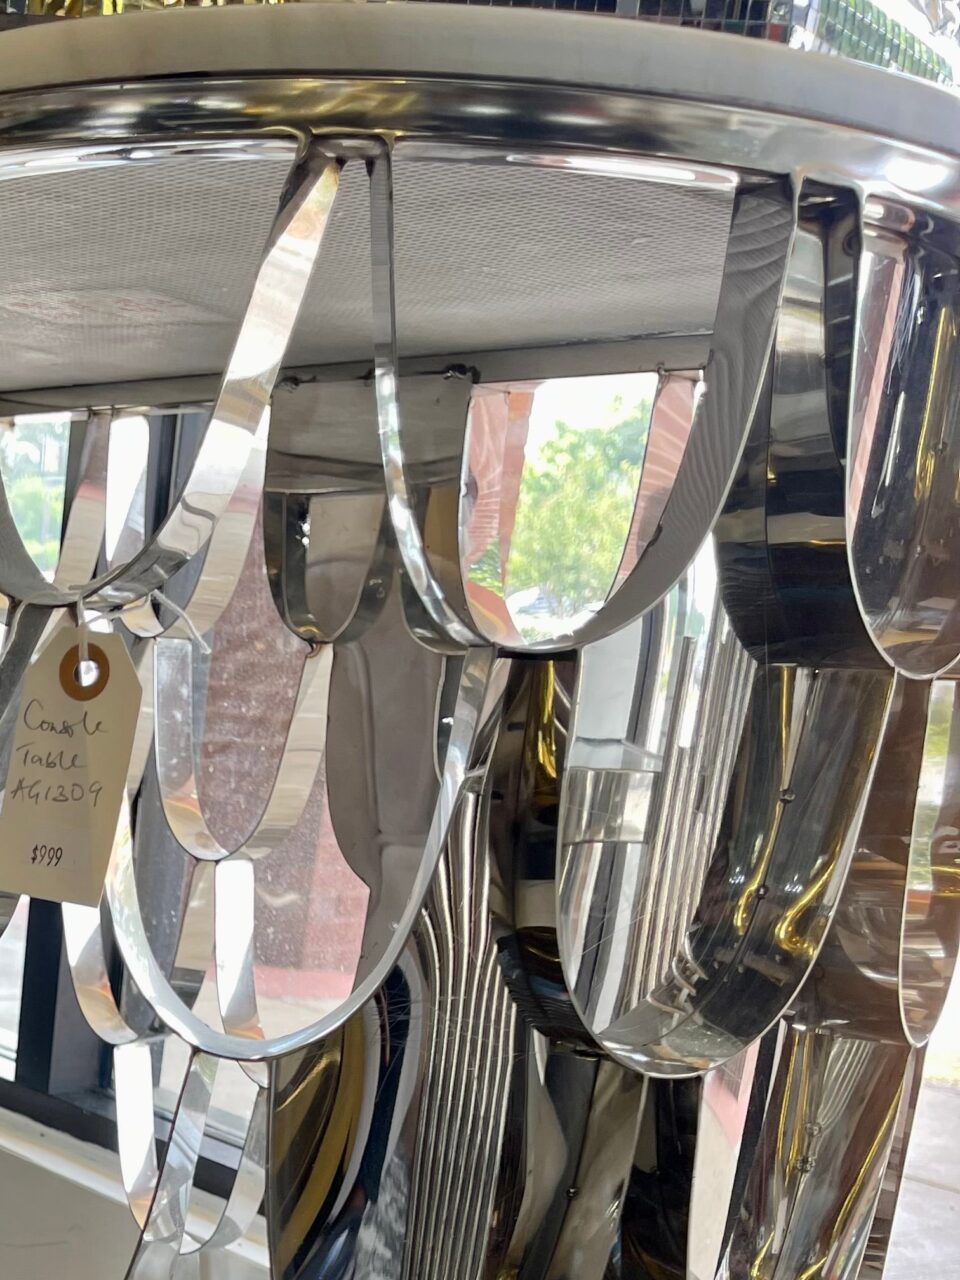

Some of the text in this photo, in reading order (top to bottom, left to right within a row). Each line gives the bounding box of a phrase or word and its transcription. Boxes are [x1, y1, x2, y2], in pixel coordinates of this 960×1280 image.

[23, 698, 108, 738] Console
[16, 743, 88, 769] Table
[31, 844, 63, 867] $999
